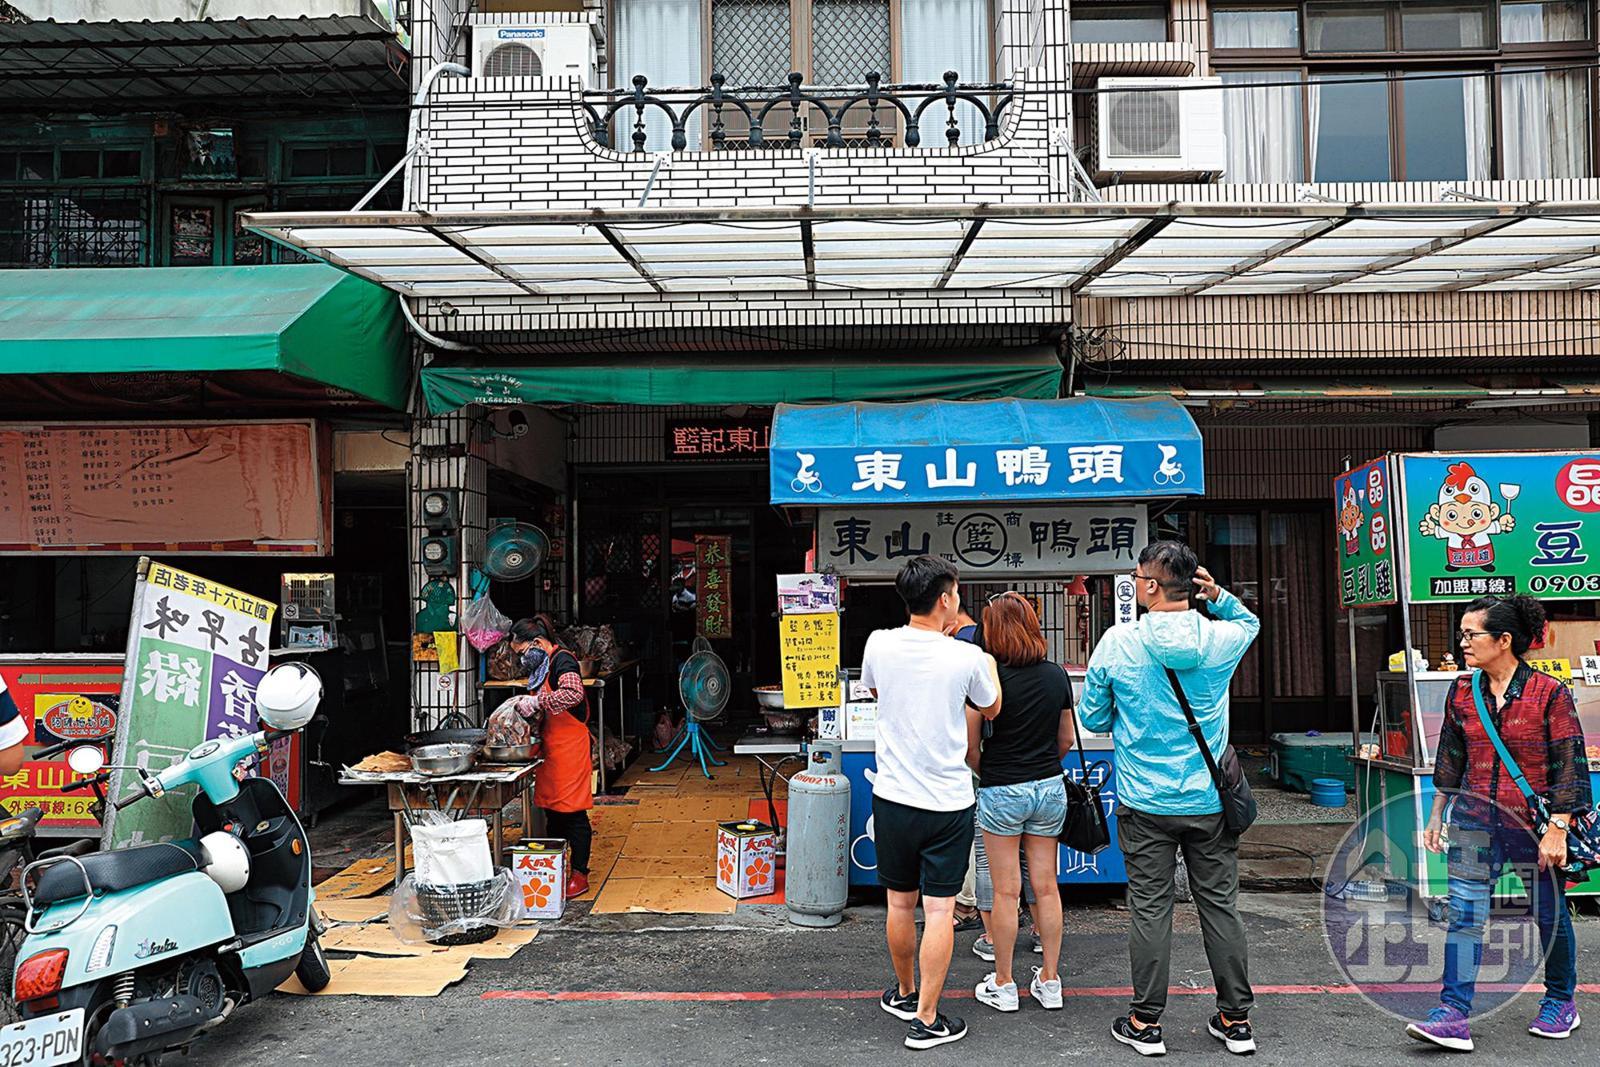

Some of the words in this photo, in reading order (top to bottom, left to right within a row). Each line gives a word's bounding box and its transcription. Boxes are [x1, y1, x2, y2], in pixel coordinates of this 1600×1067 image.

[500, 30, 543, 38] Panasonic
[852, 445, 1124, 491] 東山鴨頭
[830, 516, 931, 564] 東山
[1030, 517, 1138, 561] 鴨頭
[1530, 521, 1588, 566] 豆
[704, 543, 726, 634] 恭喜發財
[1434, 578, 1513, 594] 加盟專線:
